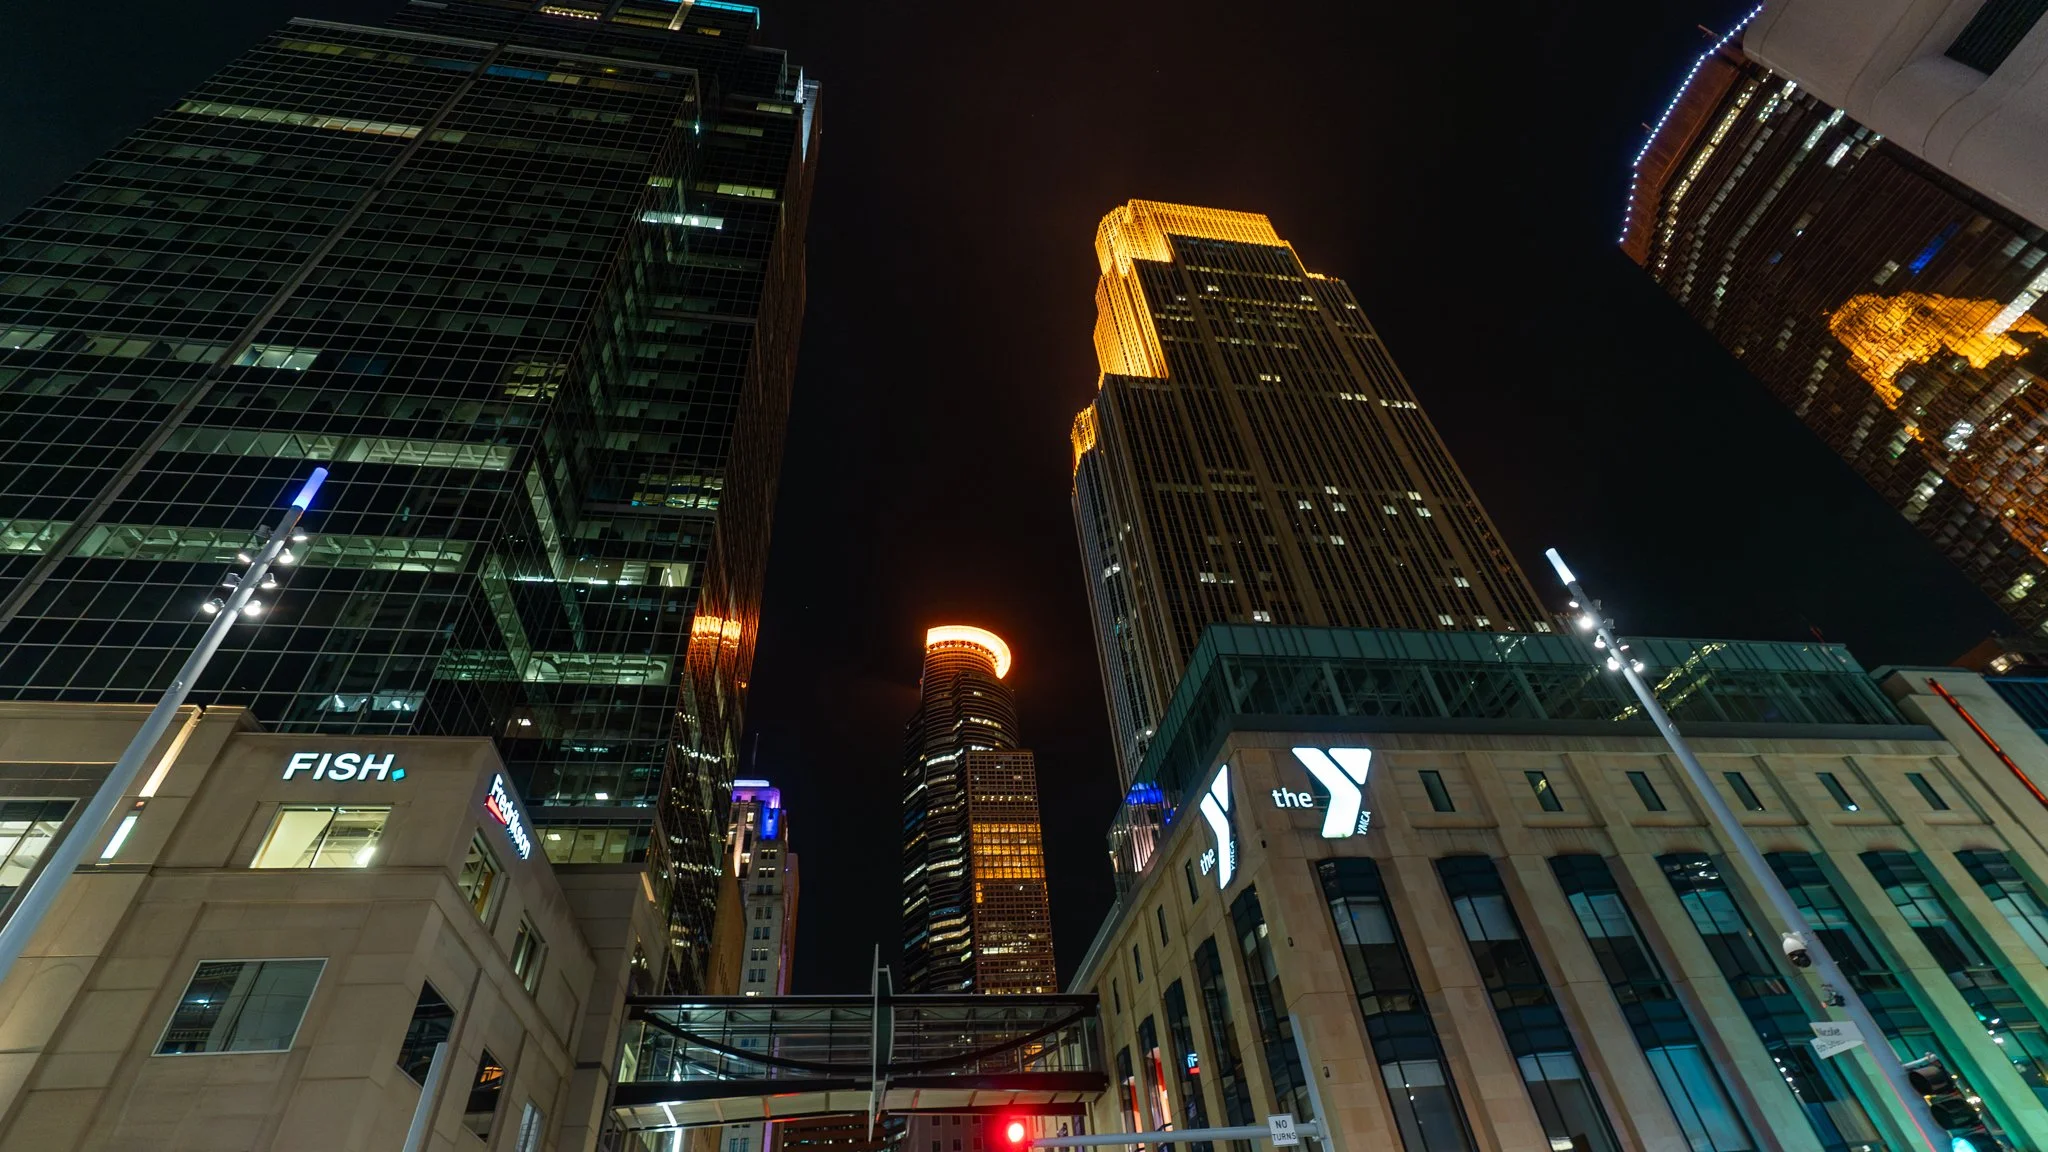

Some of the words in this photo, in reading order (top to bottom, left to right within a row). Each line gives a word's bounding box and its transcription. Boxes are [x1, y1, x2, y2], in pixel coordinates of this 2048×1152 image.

[281, 752, 396, 781] FISH
[1272, 787, 1314, 809] the
[1292, 747, 1372, 838] Y
[489, 773, 531, 860] Fredrikson
[1200, 764, 1231, 889] Y
[1357, 810, 1371, 836] YMCA
[1200, 848, 1216, 876] the
[1272, 1131, 1297, 1141] TURNS
[1275, 1119, 1288, 1129] NO
